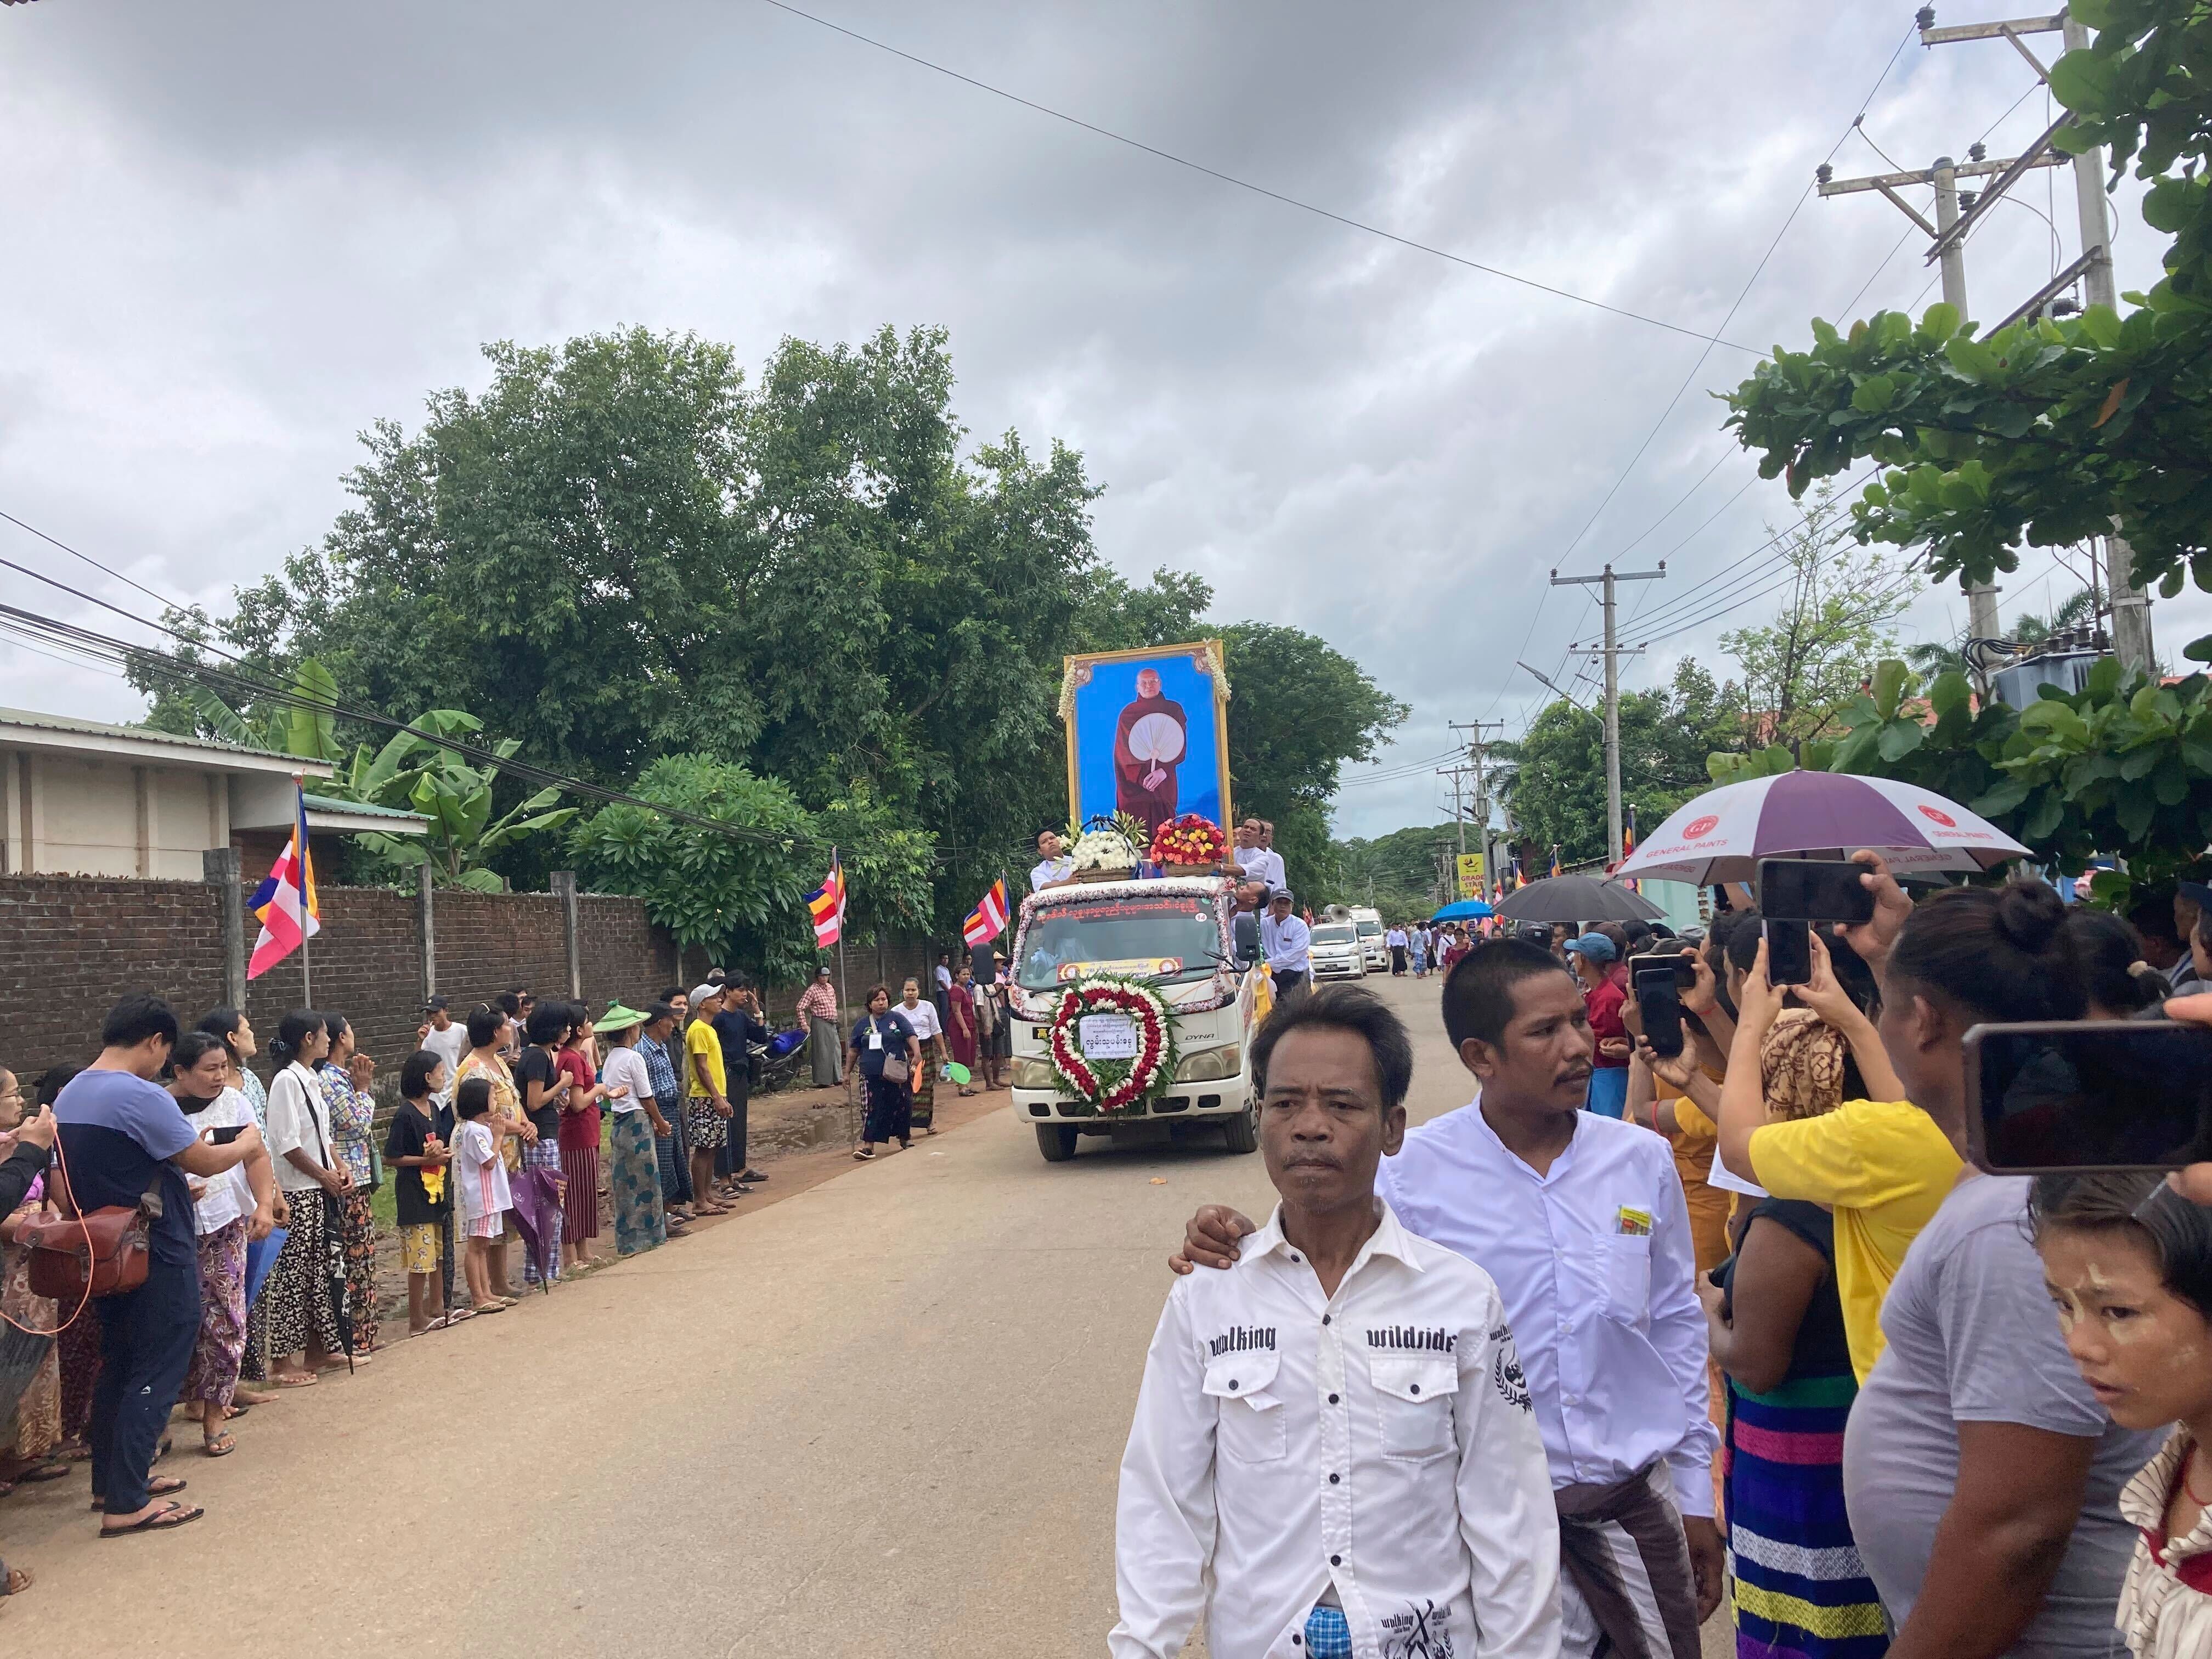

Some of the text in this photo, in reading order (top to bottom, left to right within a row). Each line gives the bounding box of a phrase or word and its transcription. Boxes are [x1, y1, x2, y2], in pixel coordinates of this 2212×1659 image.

[1646, 839, 1728, 858] GENERAL PAINTS
[1465, 879, 1483, 888] STAR
[1209, 1325, 1277, 1357] walking
[1366, 1324, 1458, 1353] wildside
[1381, 1613, 1414, 1628] walking
